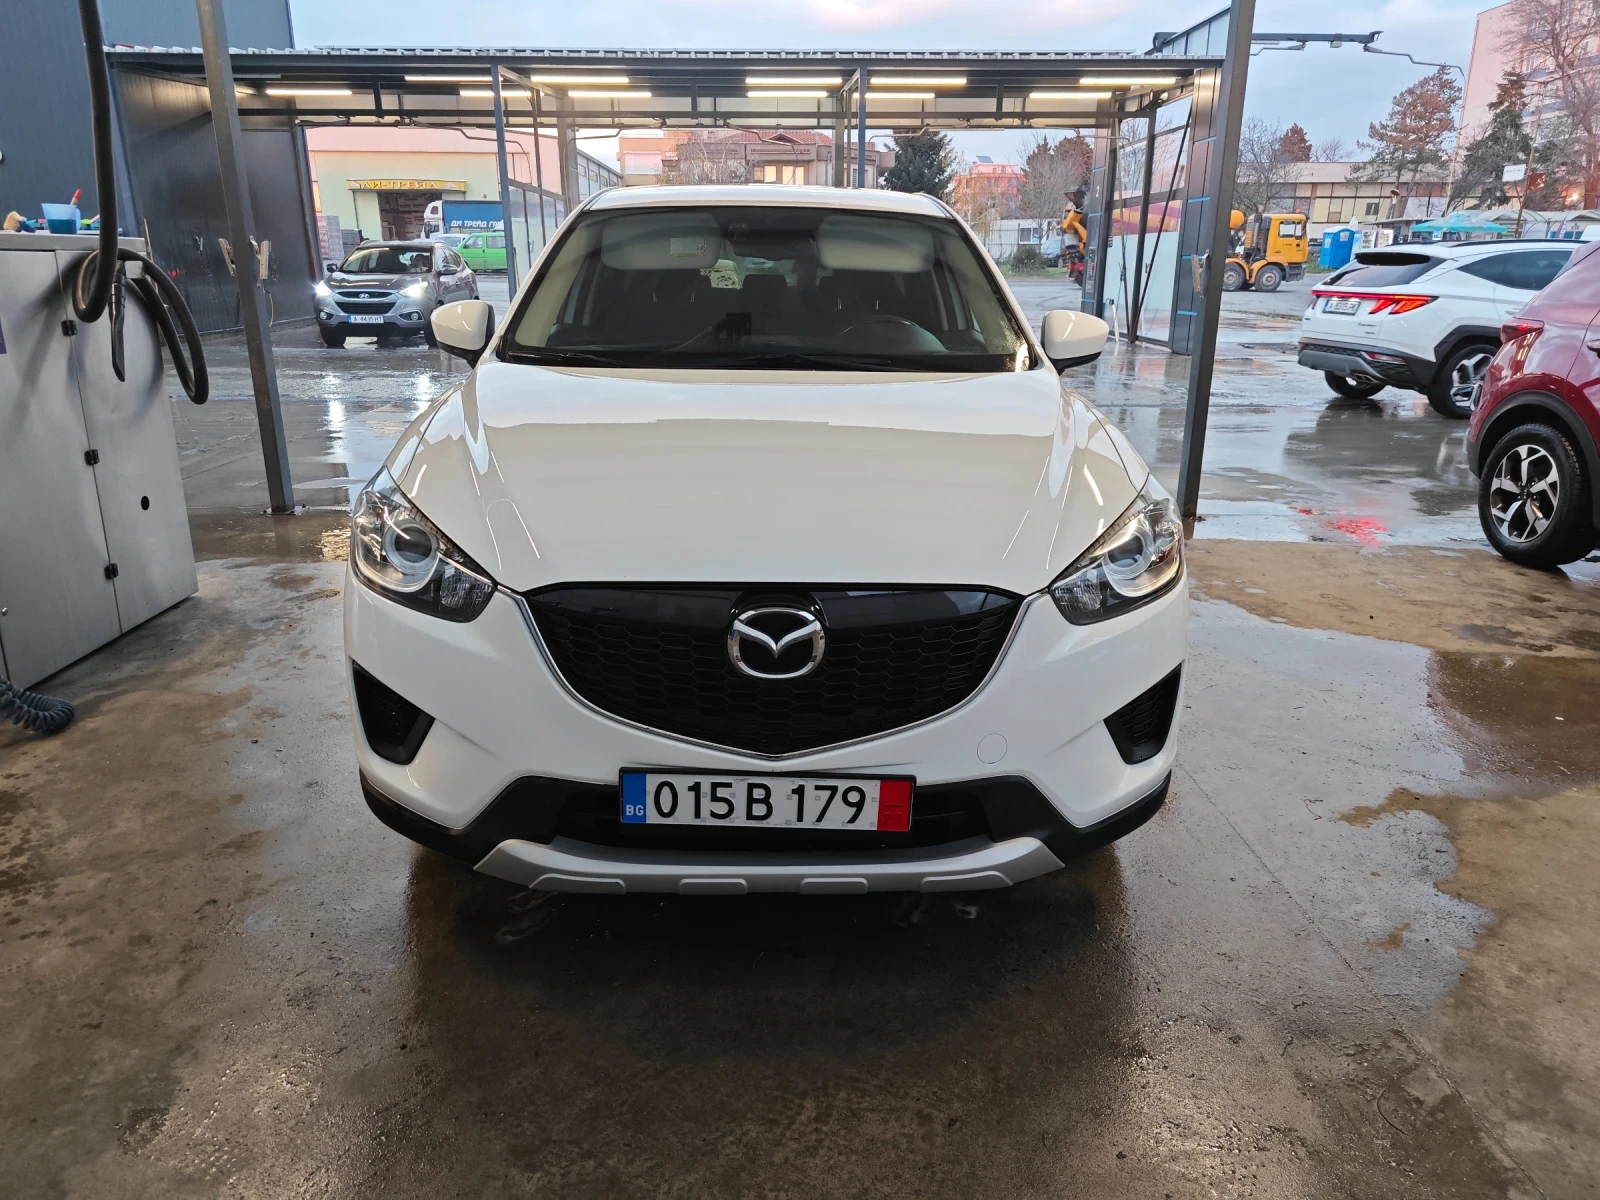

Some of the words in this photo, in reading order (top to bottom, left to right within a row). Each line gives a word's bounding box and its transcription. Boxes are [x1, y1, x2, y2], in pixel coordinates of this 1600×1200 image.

[361, 181, 438, 189] ДИ-ТРЕЙД
[1095, 185, 1100, 198] 2
[464, 219, 487, 228] ТРЕЙД
[625, 804, 644, 816] BG
